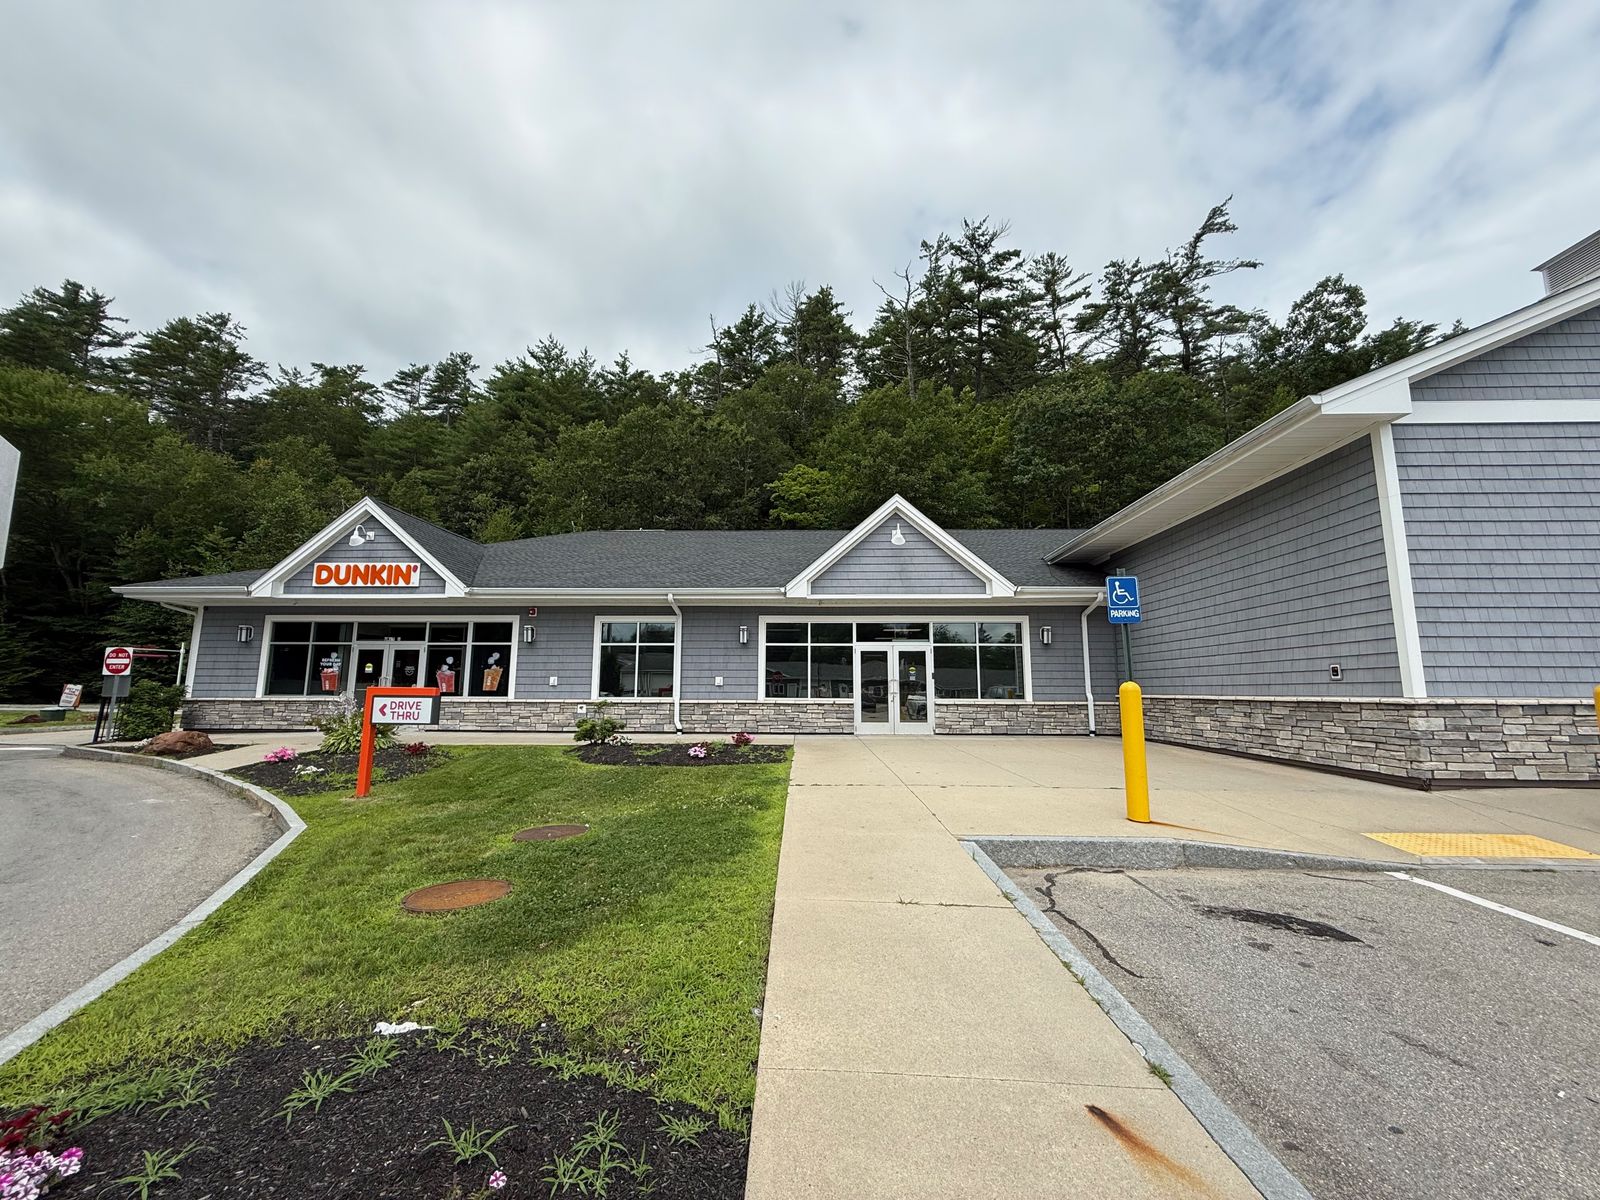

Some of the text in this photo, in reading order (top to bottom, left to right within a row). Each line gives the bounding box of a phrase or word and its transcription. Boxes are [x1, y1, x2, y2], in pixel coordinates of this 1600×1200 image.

[315, 564, 418, 585] DUNKIN'
[1110, 609, 1139, 618] PARKING
[390, 701, 422, 710] DRIVE
[390, 711, 420, 720] THRU
